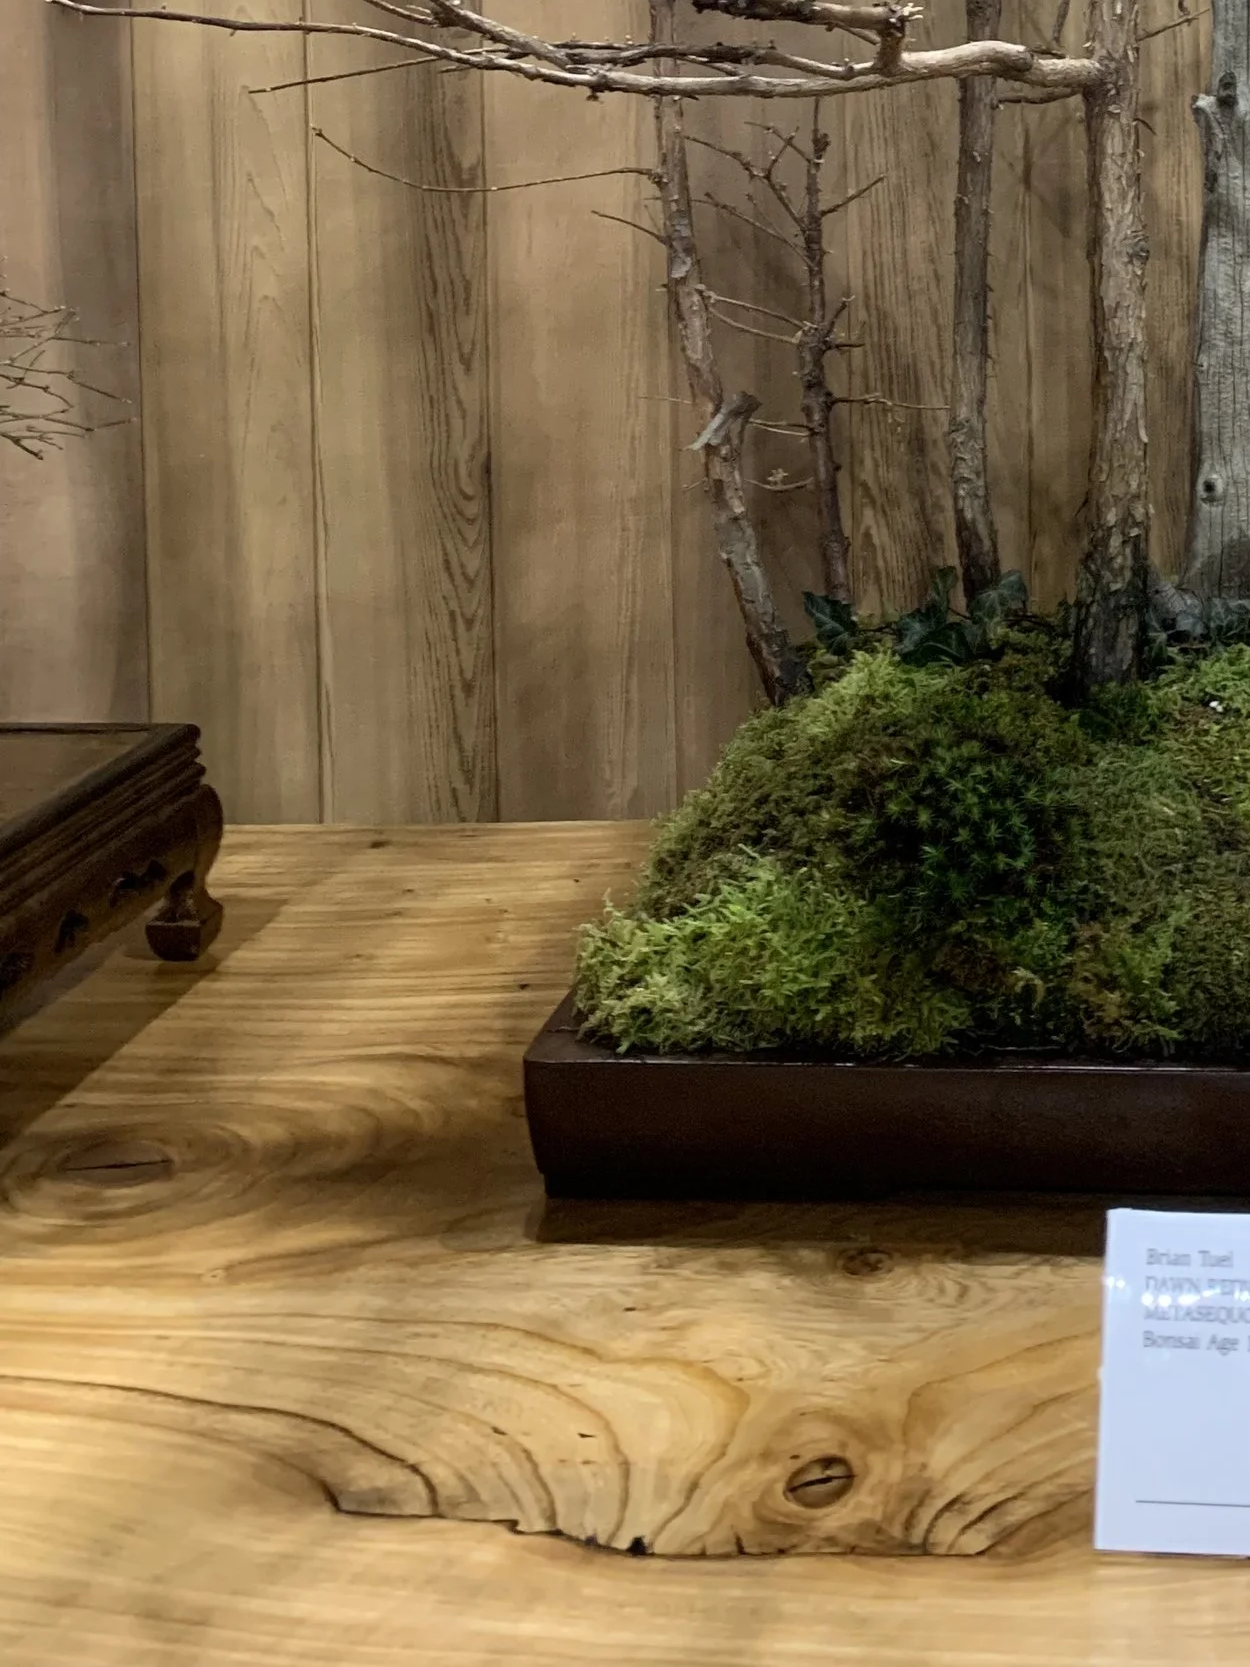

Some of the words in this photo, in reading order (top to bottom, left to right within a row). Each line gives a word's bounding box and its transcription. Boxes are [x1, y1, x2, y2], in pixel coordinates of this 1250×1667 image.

[1146, 1248, 1191, 1266] Brian
[1146, 1276, 1200, 1294] DAWN
[1143, 1330, 1200, 1349] Bonsai
[1206, 1333, 1240, 1356] Age
